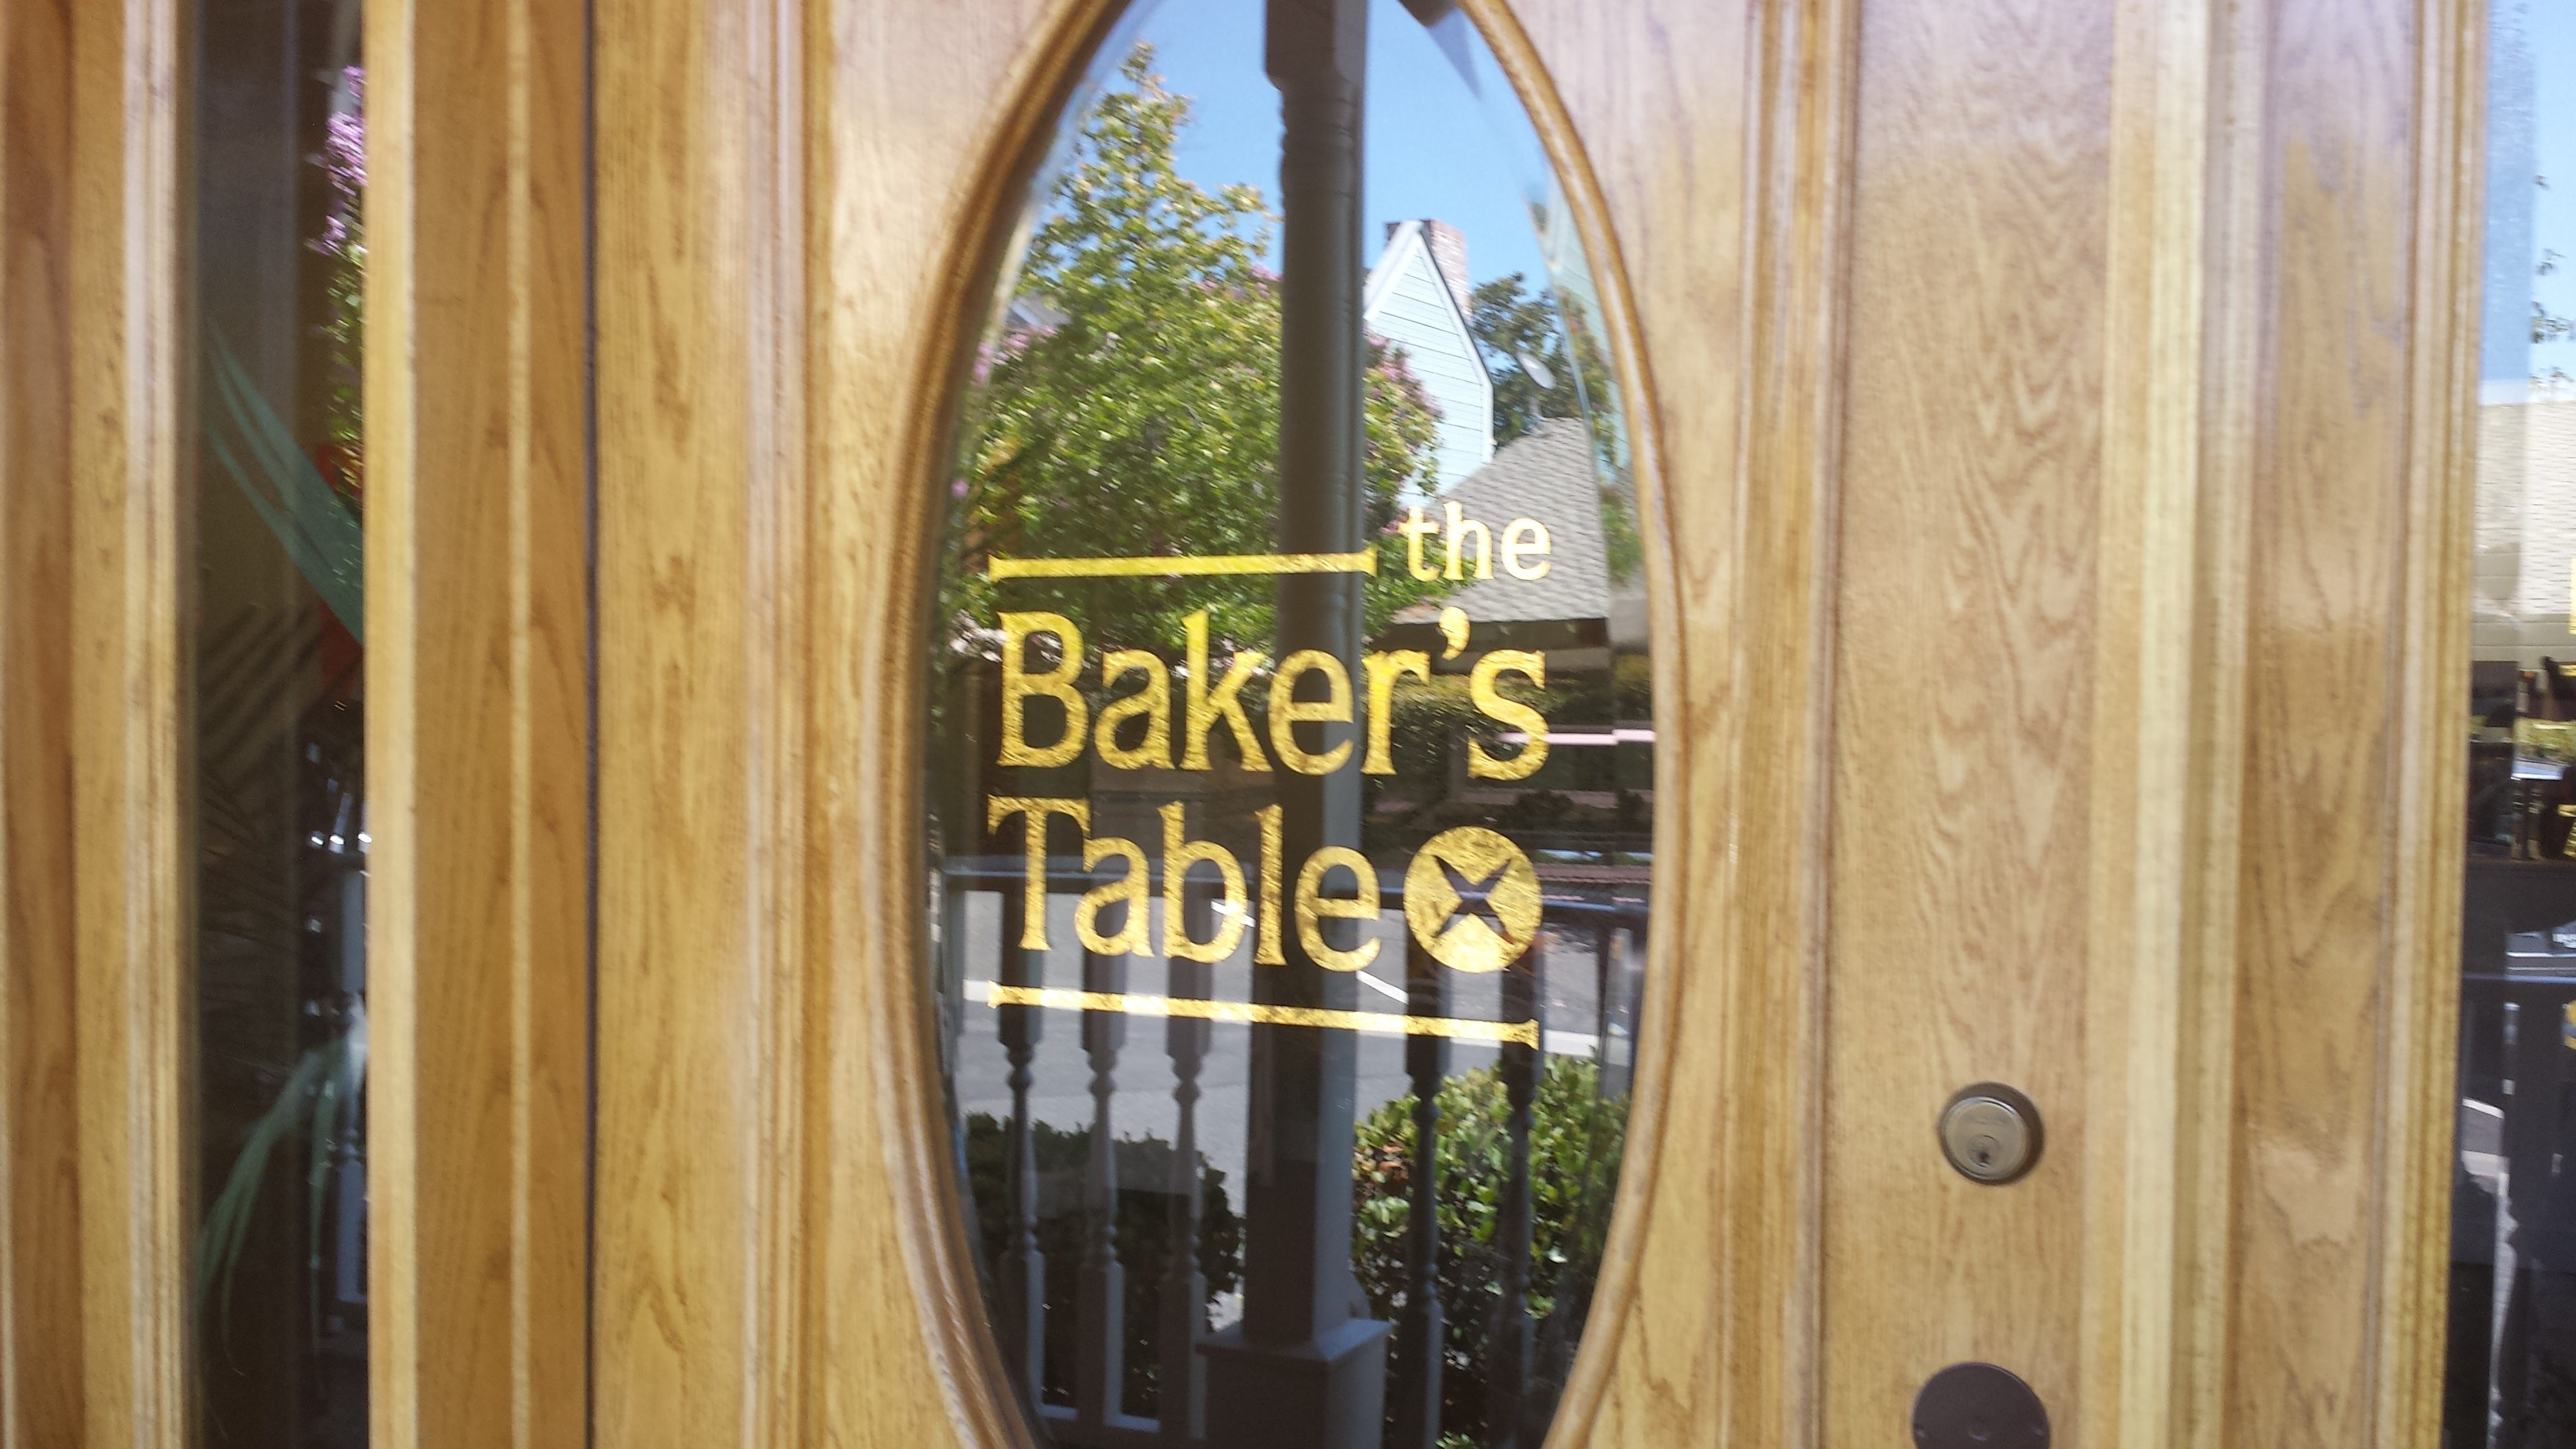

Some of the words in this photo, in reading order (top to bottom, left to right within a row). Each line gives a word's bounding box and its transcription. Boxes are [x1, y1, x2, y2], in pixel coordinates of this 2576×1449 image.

[1399, 502, 1551, 582] the
[997, 607, 1549, 780] Baker's
[987, 794, 1382, 972] Table
